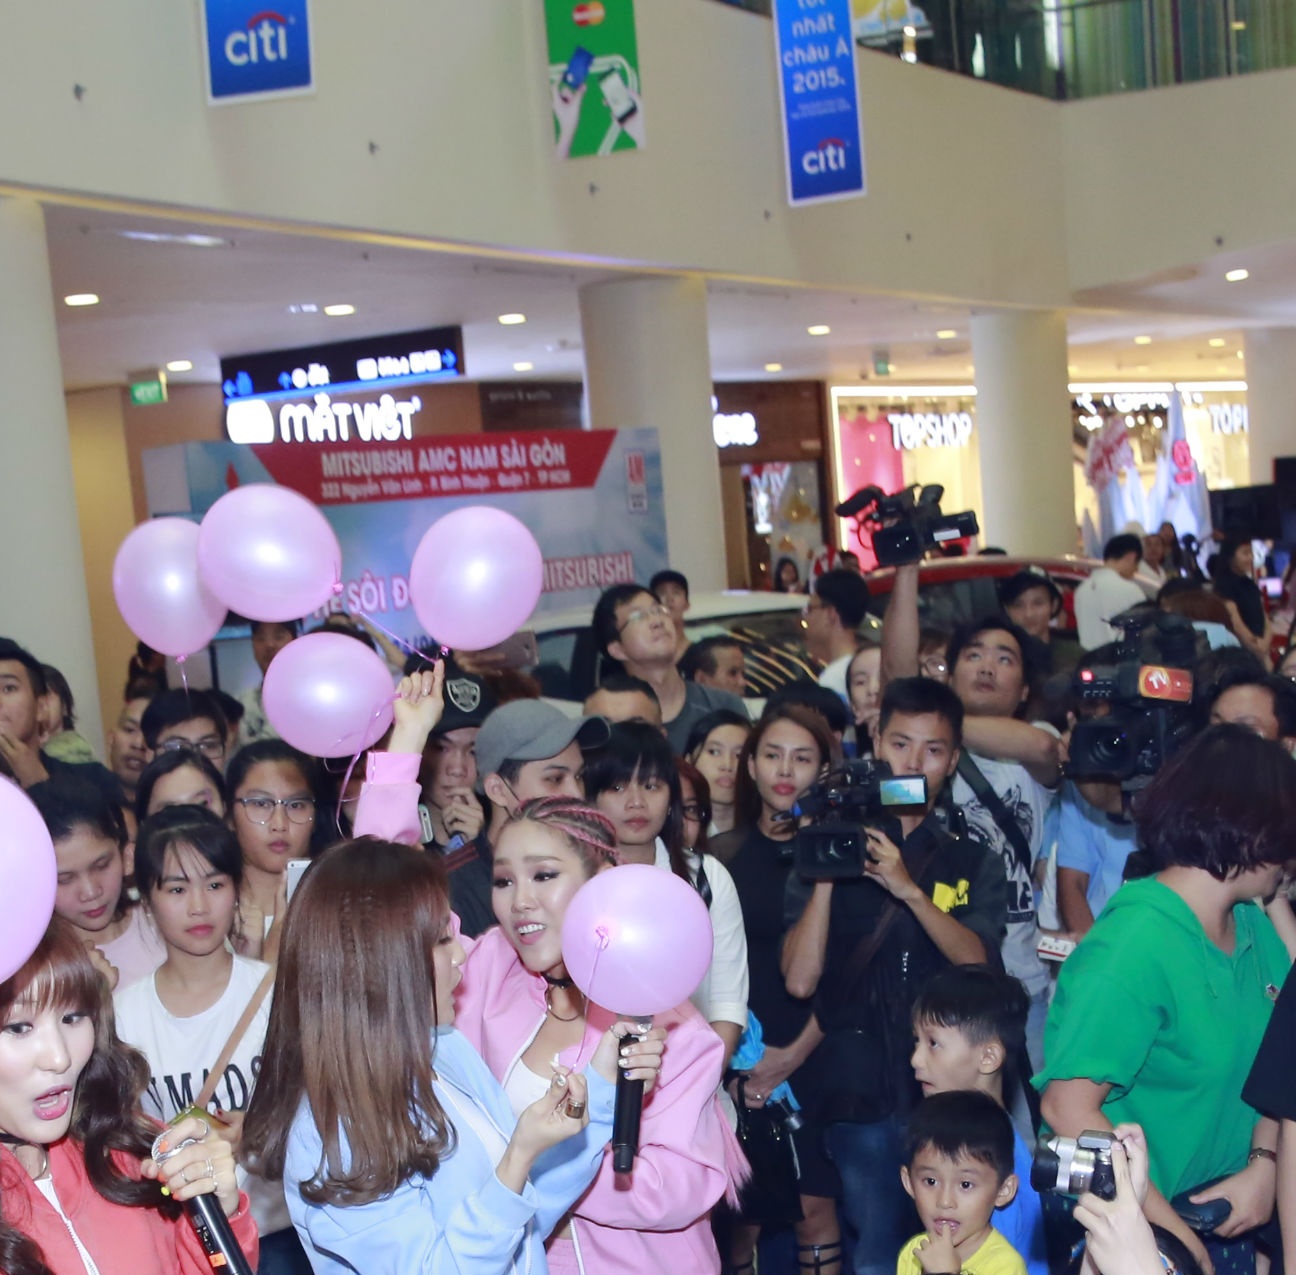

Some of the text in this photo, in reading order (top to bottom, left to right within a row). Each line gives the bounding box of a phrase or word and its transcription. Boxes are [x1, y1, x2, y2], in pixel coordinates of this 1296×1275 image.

[225, 14, 287, 66] citi
[802, 140, 846, 175] citi
[887, 411, 972, 451] TOPSHOP
[321, 437, 566, 478] MITSUBISHI AMC NAM SÀI GÒN
